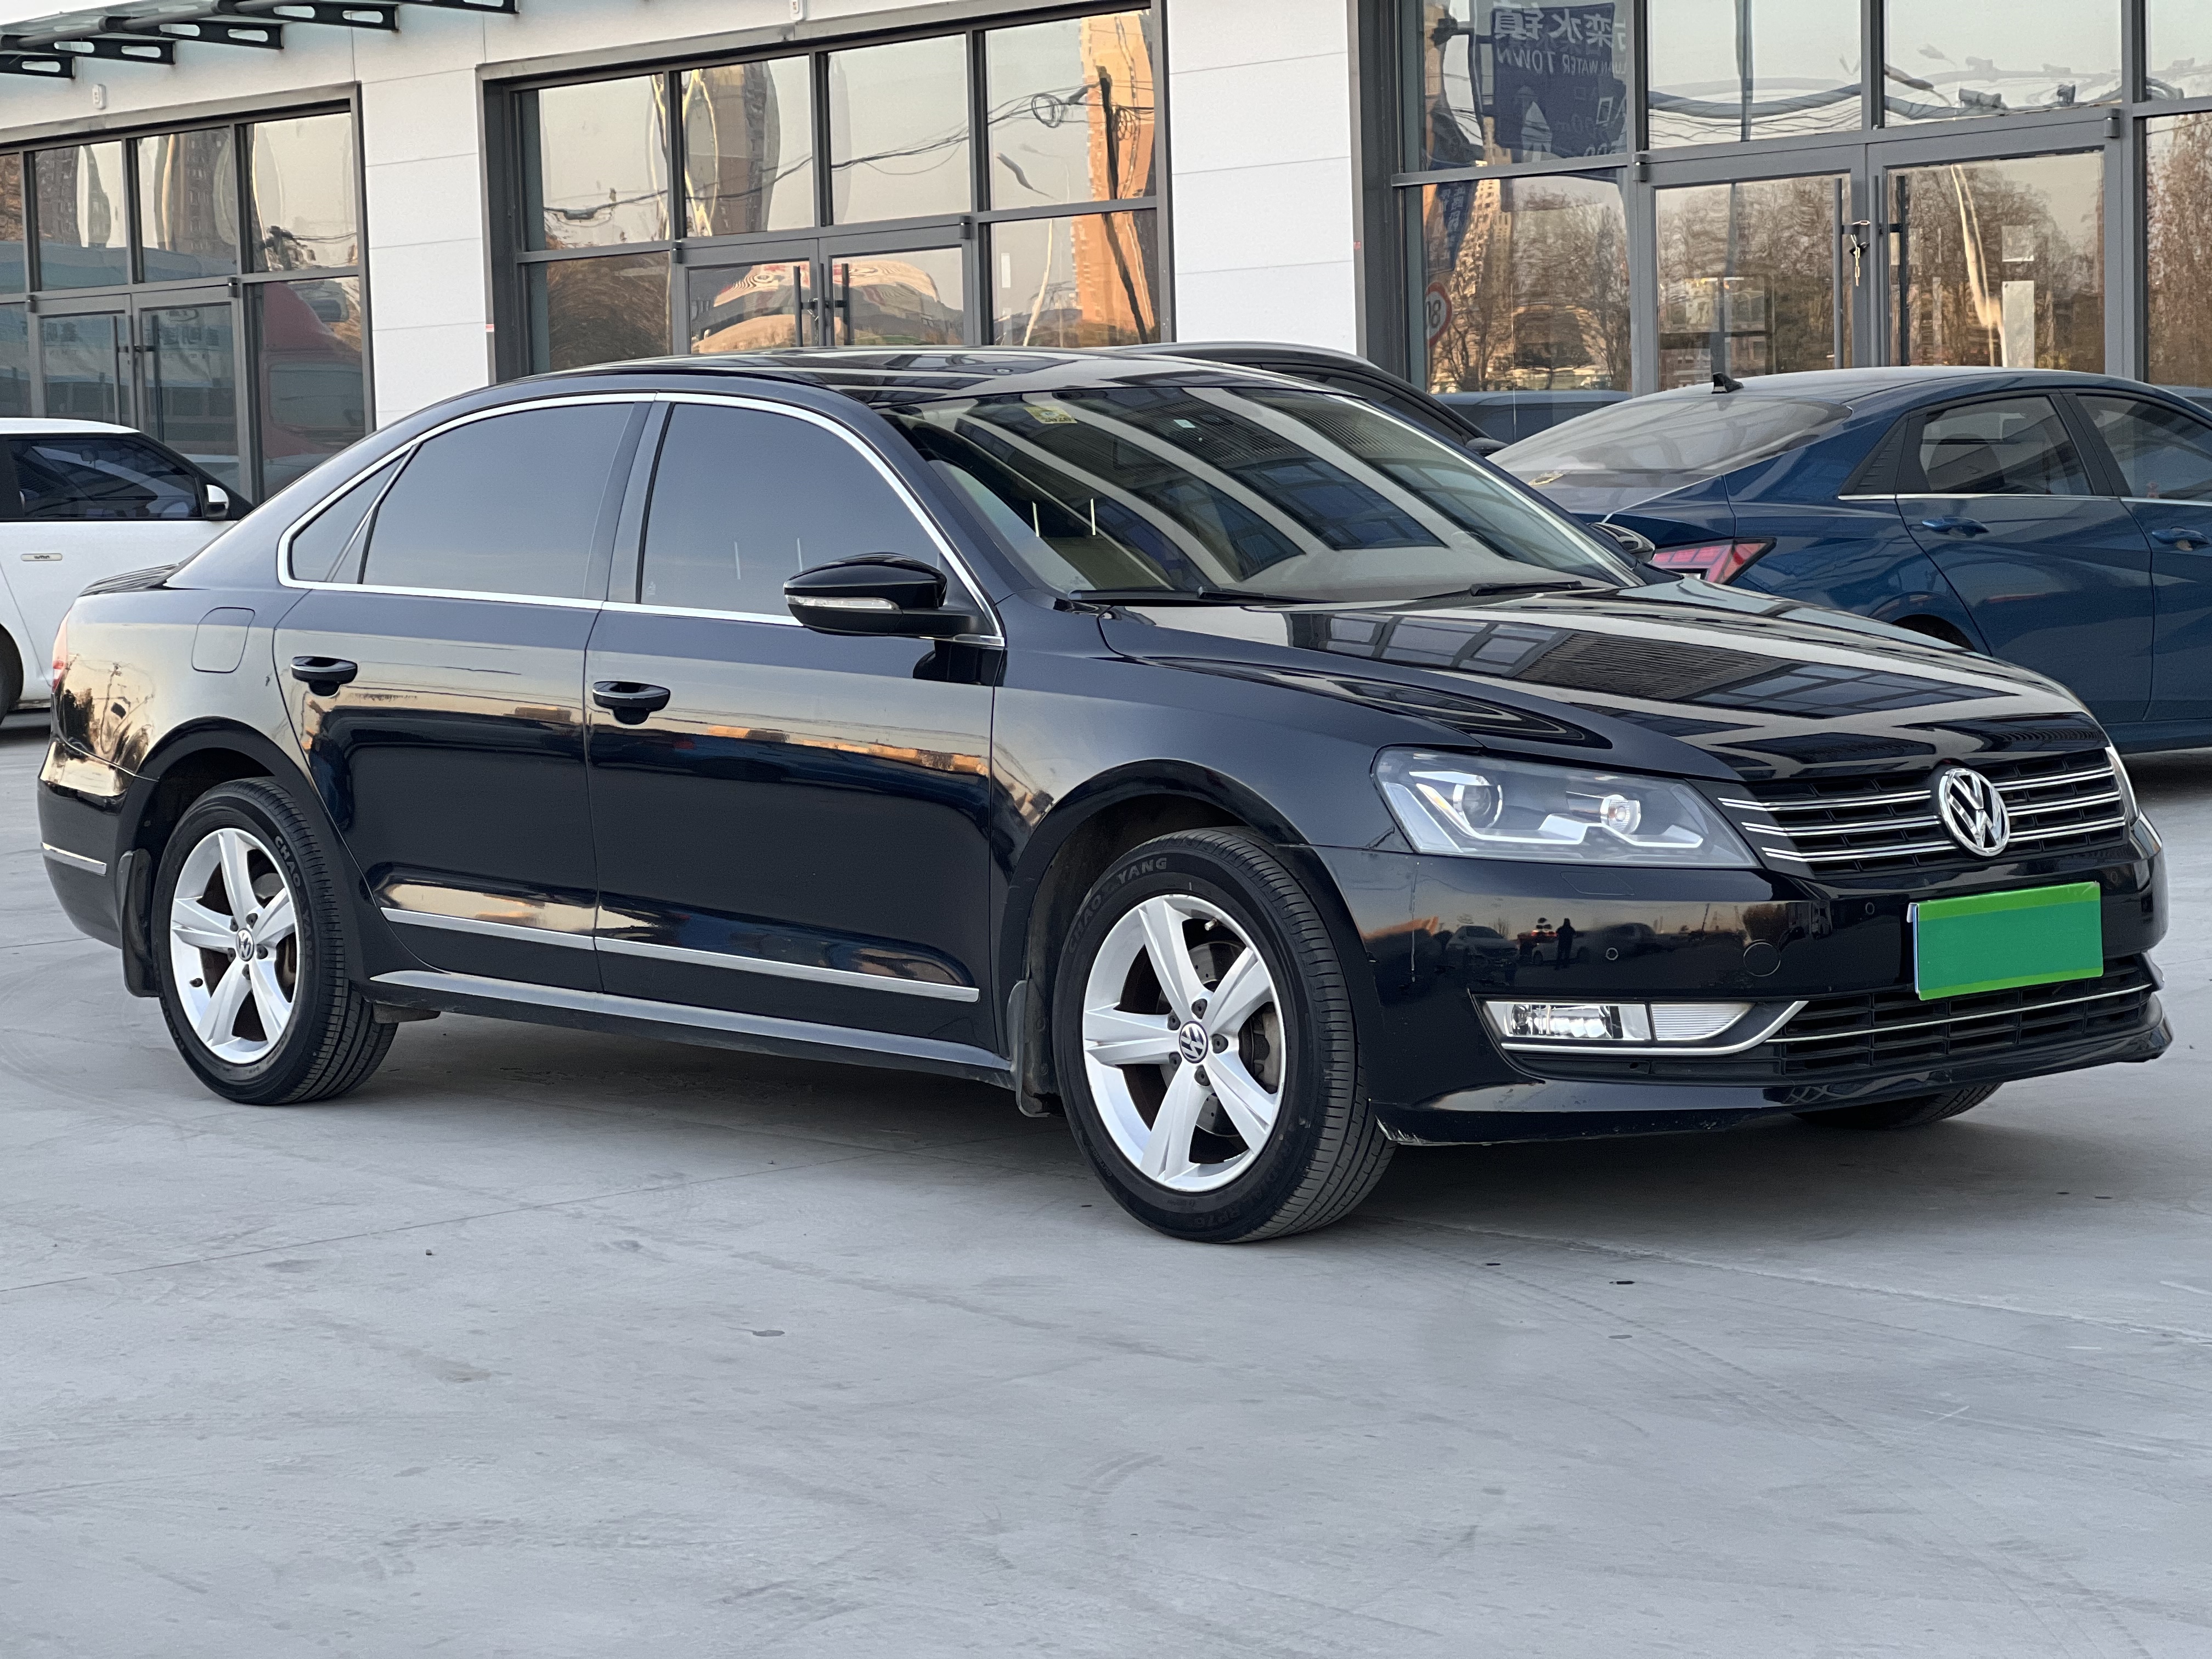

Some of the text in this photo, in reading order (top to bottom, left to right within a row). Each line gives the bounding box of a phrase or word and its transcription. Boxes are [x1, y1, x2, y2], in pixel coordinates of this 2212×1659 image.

[274, 836, 301, 887] CHAO
[1068, 857, 1167, 953] CHAO YANG
